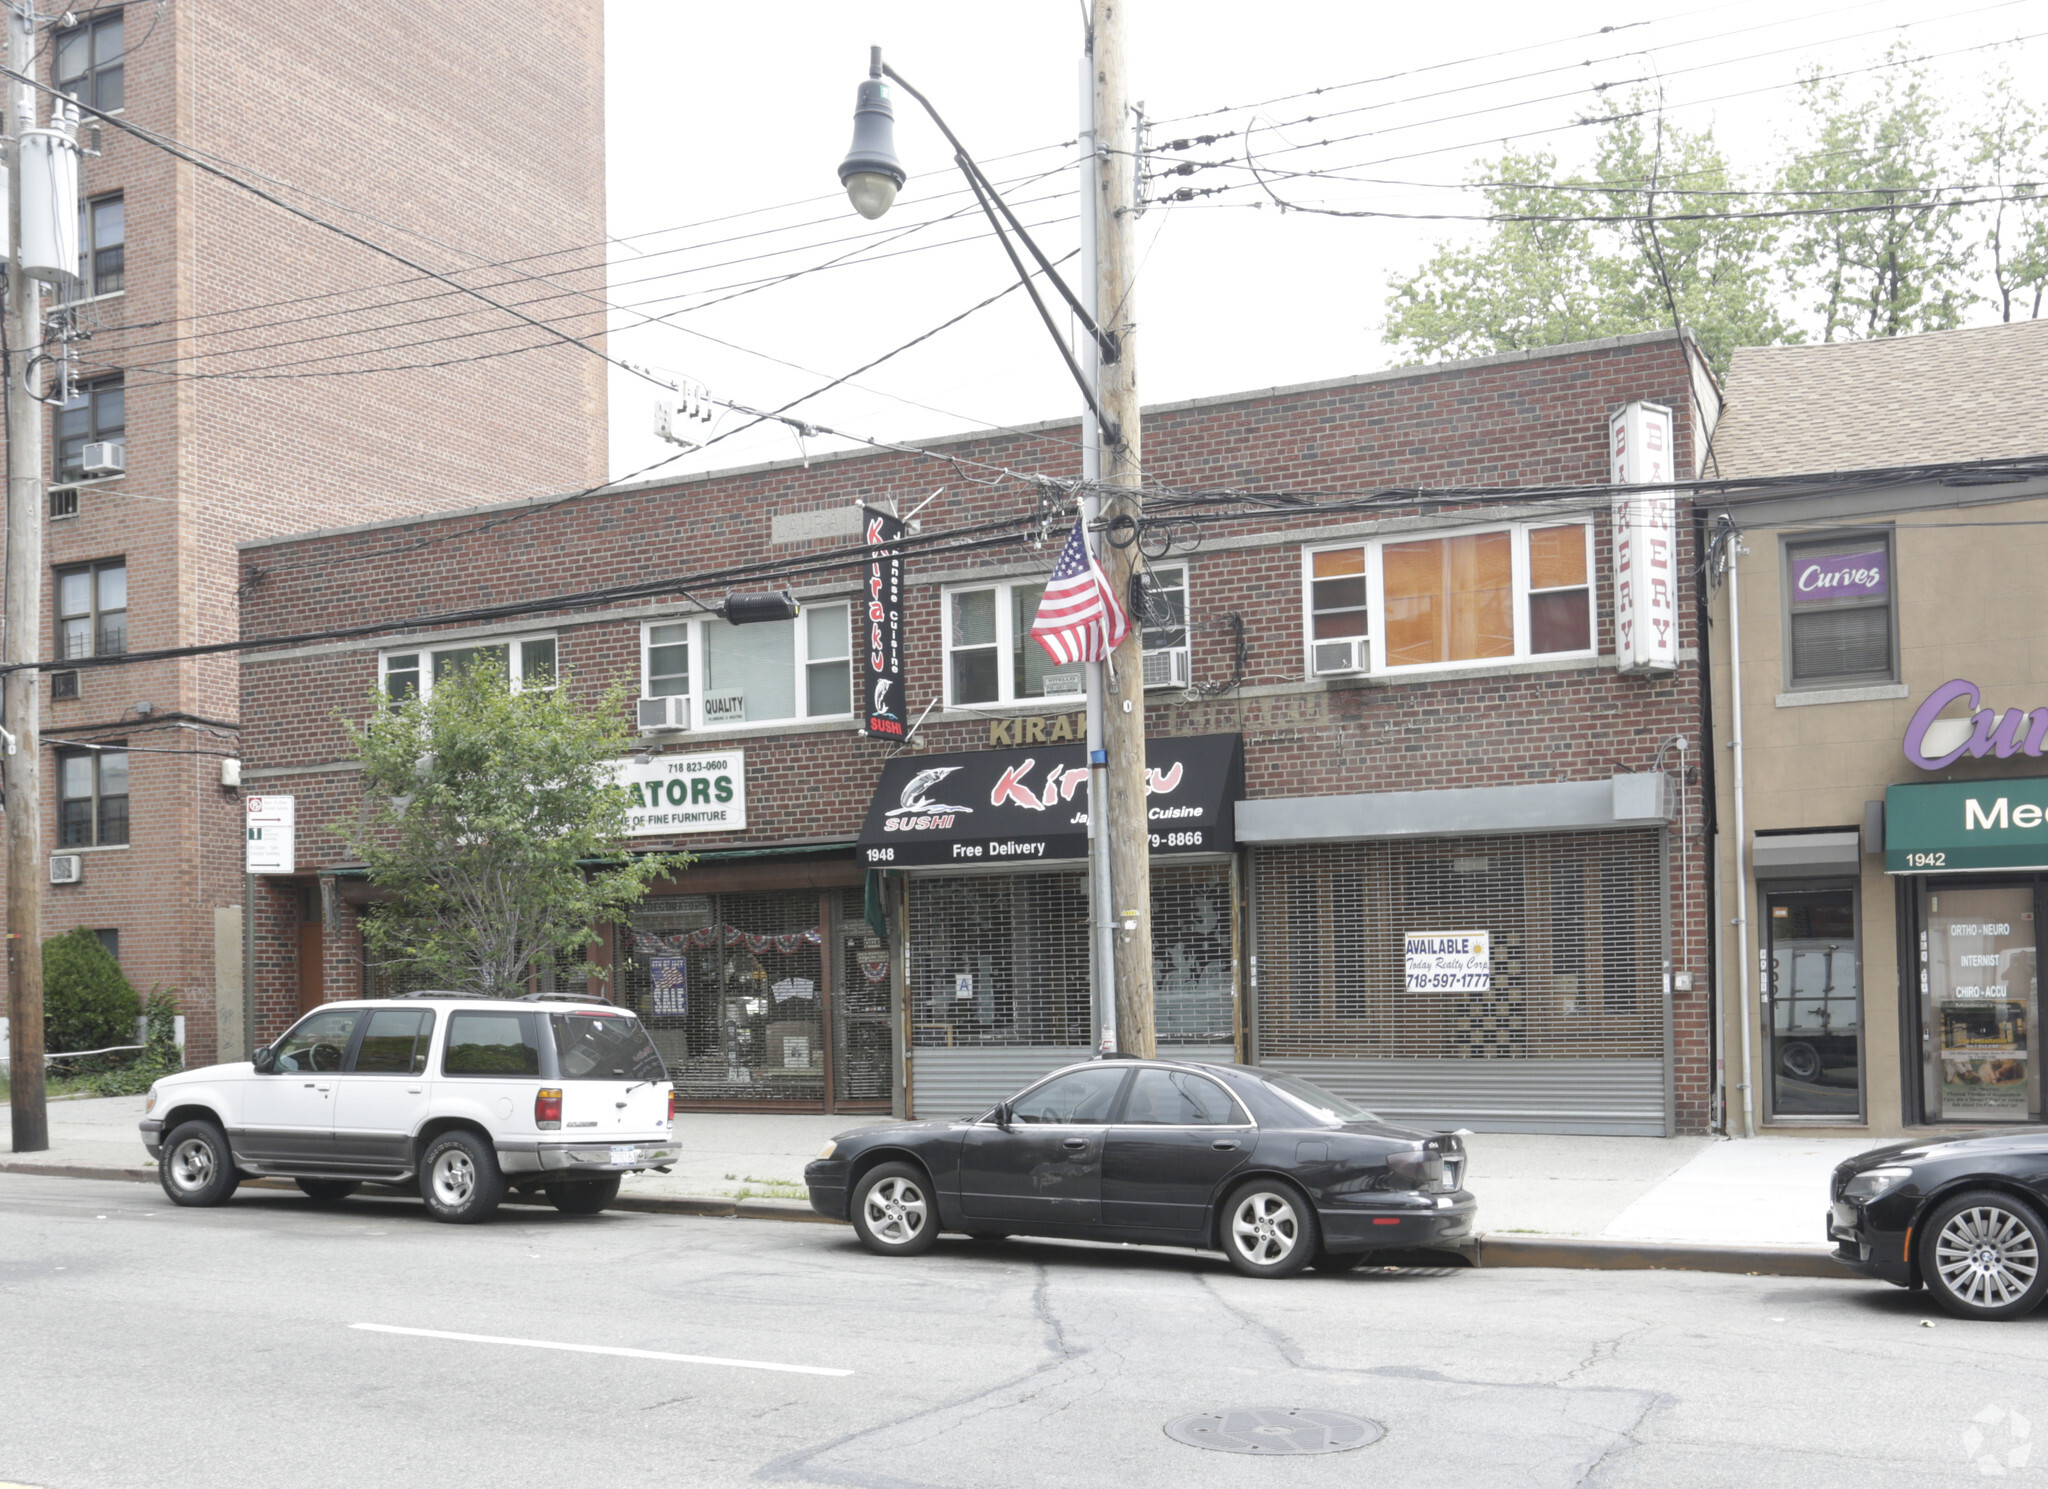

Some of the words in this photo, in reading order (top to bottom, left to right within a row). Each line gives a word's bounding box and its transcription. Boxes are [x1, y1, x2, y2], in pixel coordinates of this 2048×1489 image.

[1615, 424, 1633, 651] BAKERY
[1646, 421, 1671, 649] BAKERY
[1798, 564, 1880, 592] Curves
[705, 696, 743, 715] QUALITY
[870, 716, 902, 735] SUSHI
[668, 763, 683, 773] 718
[686, 760, 728, 772] 823-0600
[628, 775, 734, 808] ATORS
[990, 758, 1184, 811] Kiru
[648, 815, 670, 825] FINE
[672, 811, 727, 823] FURNITURE
[1148, 805, 1204, 820] Cuisine
[1965, 797, 2048, 831] Me
[884, 814, 956, 833] SUSHI
[866, 847, 895, 862] 1948
[953, 844, 983, 858] Free
[989, 841, 1046, 857] Delivery
[1147, 831, 1203, 848] 79-8866
[1906, 853, 1946, 867] 1942
[1951, 924, 1977, 936] ORTHO
[1983, 923, 2010, 936] NEURO
[1406, 938, 1469, 955] AVAILABLE
[1407, 957, 1432, 972] Today
[1435, 956, 1464, 972] Realty
[1960, 954, 2000, 967] INTERNIST
[959, 977, 969, 991] A
[1956, 985, 1980, 998] CHIRO
[1985, 985, 2007, 997] ACCU
